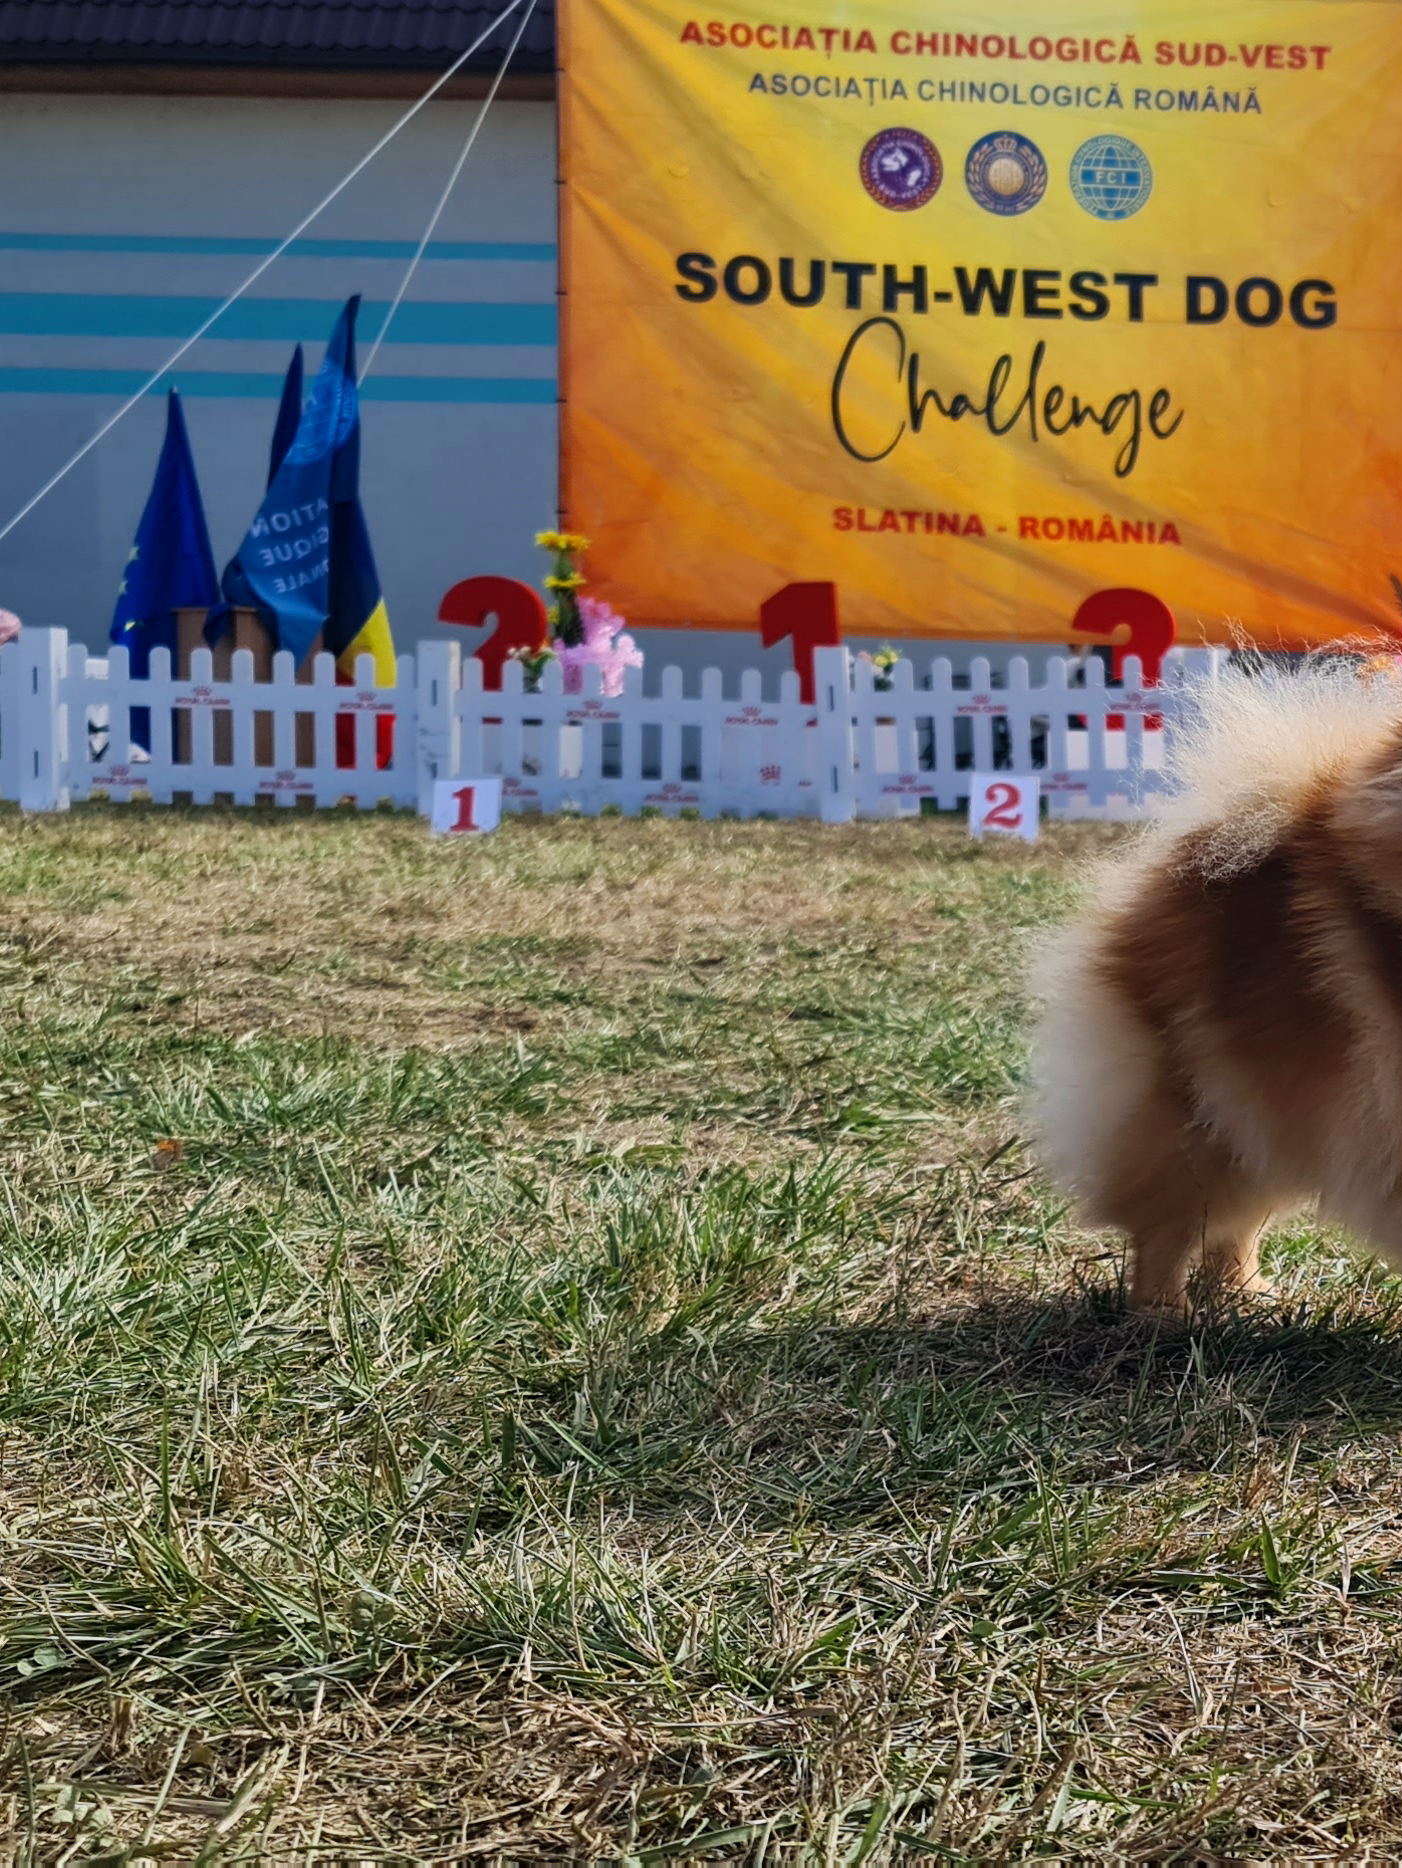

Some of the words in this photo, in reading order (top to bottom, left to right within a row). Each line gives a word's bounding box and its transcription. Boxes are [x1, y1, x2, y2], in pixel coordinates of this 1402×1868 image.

[679, 21, 878, 60] ASOCIAȚIA
[890, 30, 1142, 65] CHINOLOGICĂ
[1154, 40, 1332, 71] SUD-VEST
[749, 72, 909, 107] ASOCIAȚIA
[917, 79, 1124, 110] CHINOLOGICĂ
[1134, 85, 1263, 115] ROMÂNĂ
[1094, 171, 1127, 185] FCI
[674, 252, 1159, 323] SOUTH-WEST
[1186, 275, 1338, 330] DOG
[831, 316, 1185, 479] Challenge
[832, 507, 986, 537] SLATINA
[1018, 514, 1182, 546] ROMÂNIA
[450, 786, 479, 832] 1
[983, 782, 1023, 829] 2
